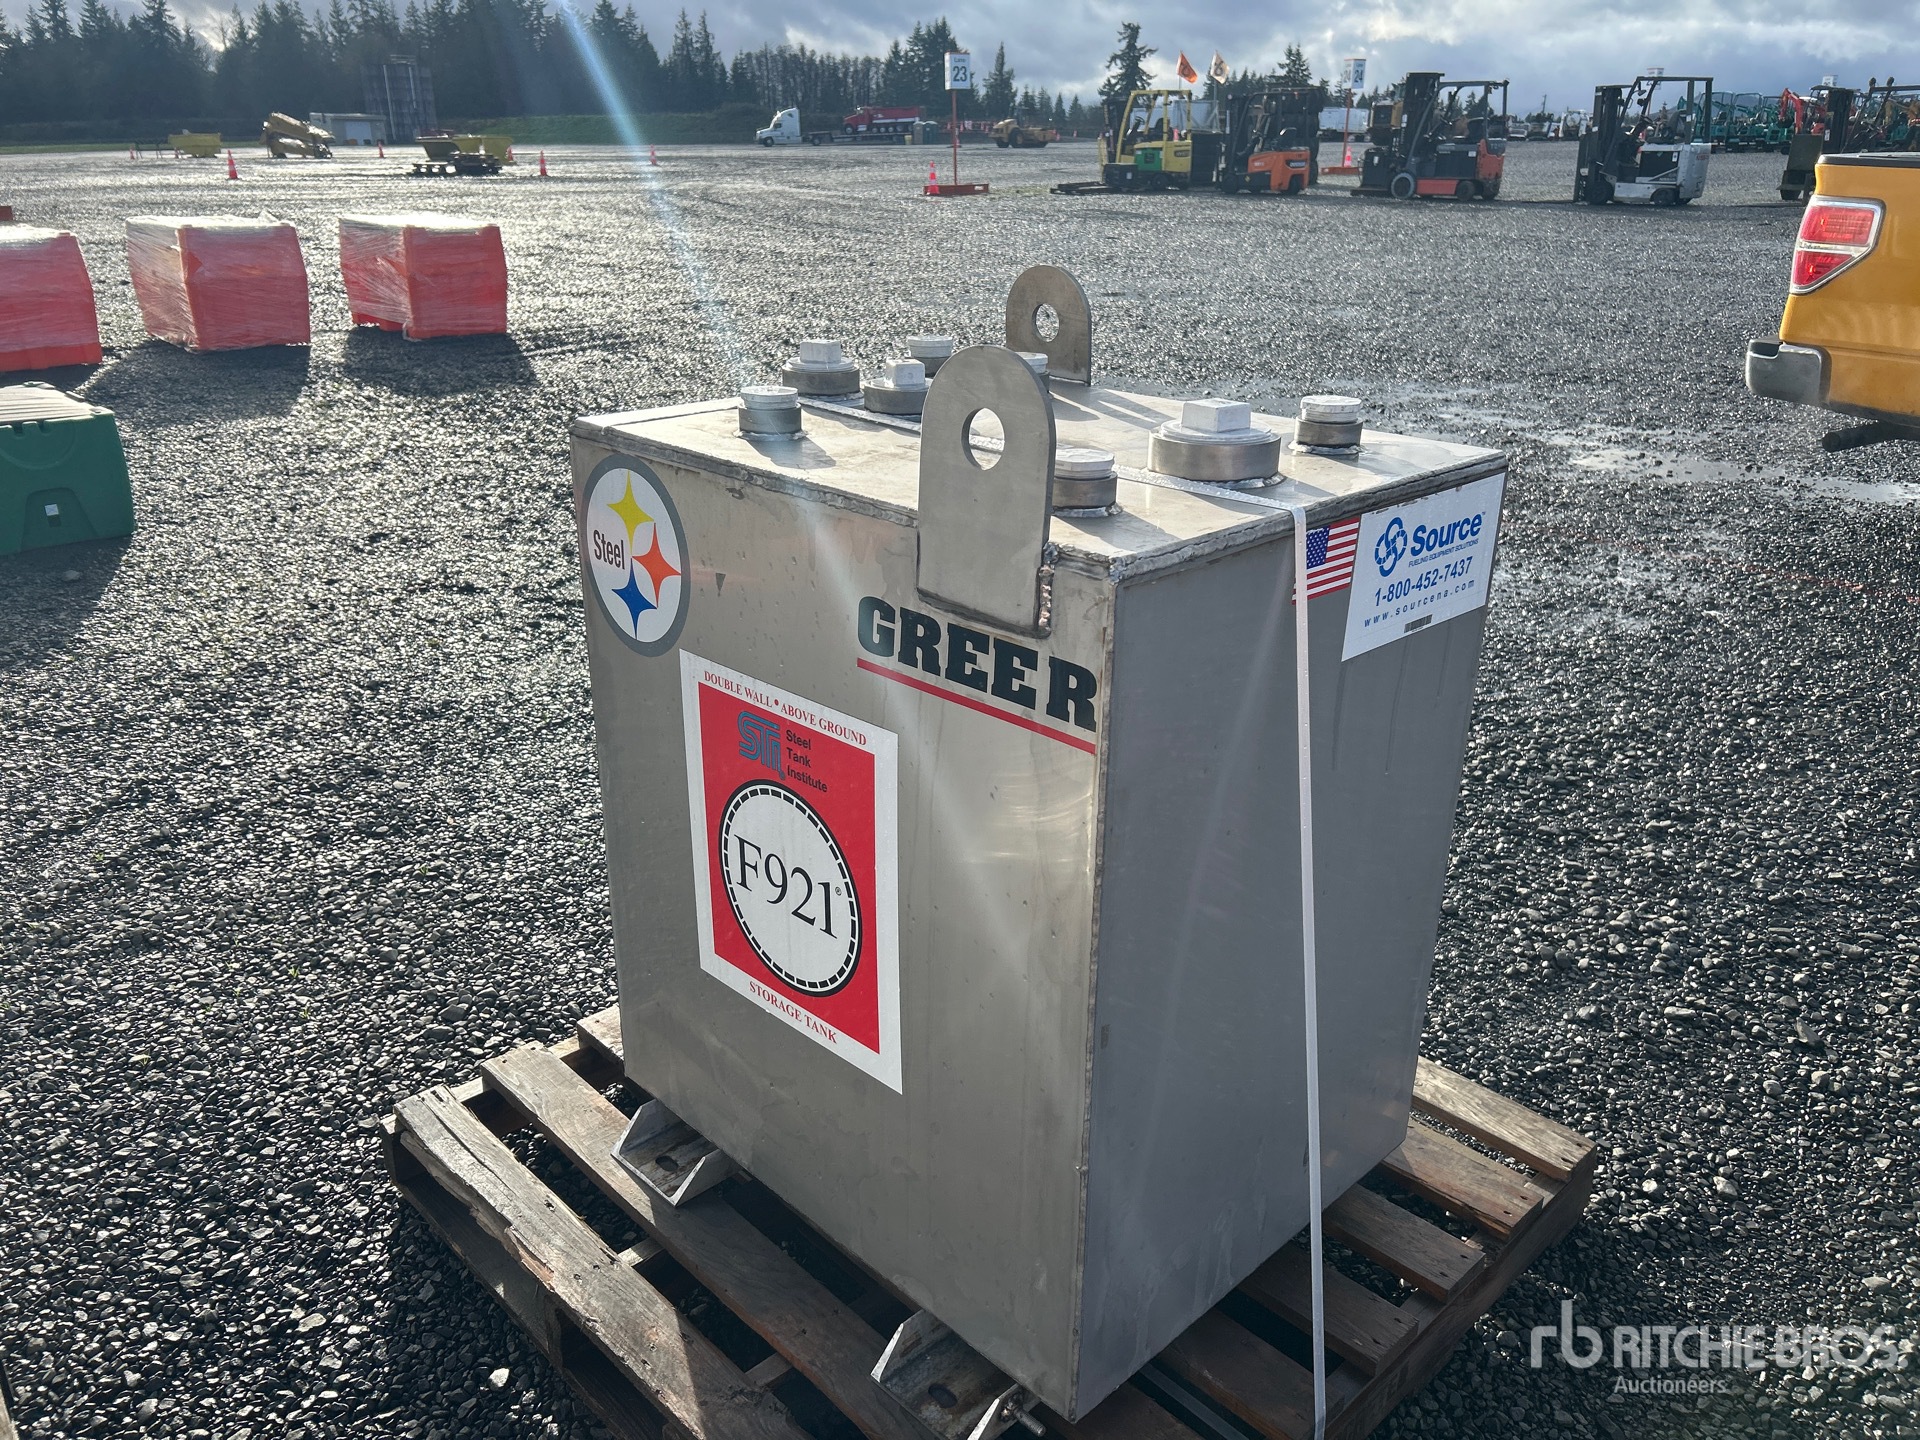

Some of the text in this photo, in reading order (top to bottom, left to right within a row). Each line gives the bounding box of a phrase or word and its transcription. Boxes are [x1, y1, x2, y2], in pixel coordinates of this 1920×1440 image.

[952, 65, 968, 82] 23
[1353, 69, 1364, 83] 24
[593, 529, 625, 570] Steel
[1408, 538, 1479, 568] FUELING EQUIPMENT SOLUTIONS
[1375, 555, 1473, 607] 1-800-452-7437
[857, 596, 1098, 732] GREER
[704, 670, 867, 746] DOUBLE WALL ABOVE GROUND
[786, 729, 812, 751] Steel
[786, 747, 811, 768] Tank
[787, 764, 828, 793] Institute
[749, 981, 837, 1044] STORAGE TANK
